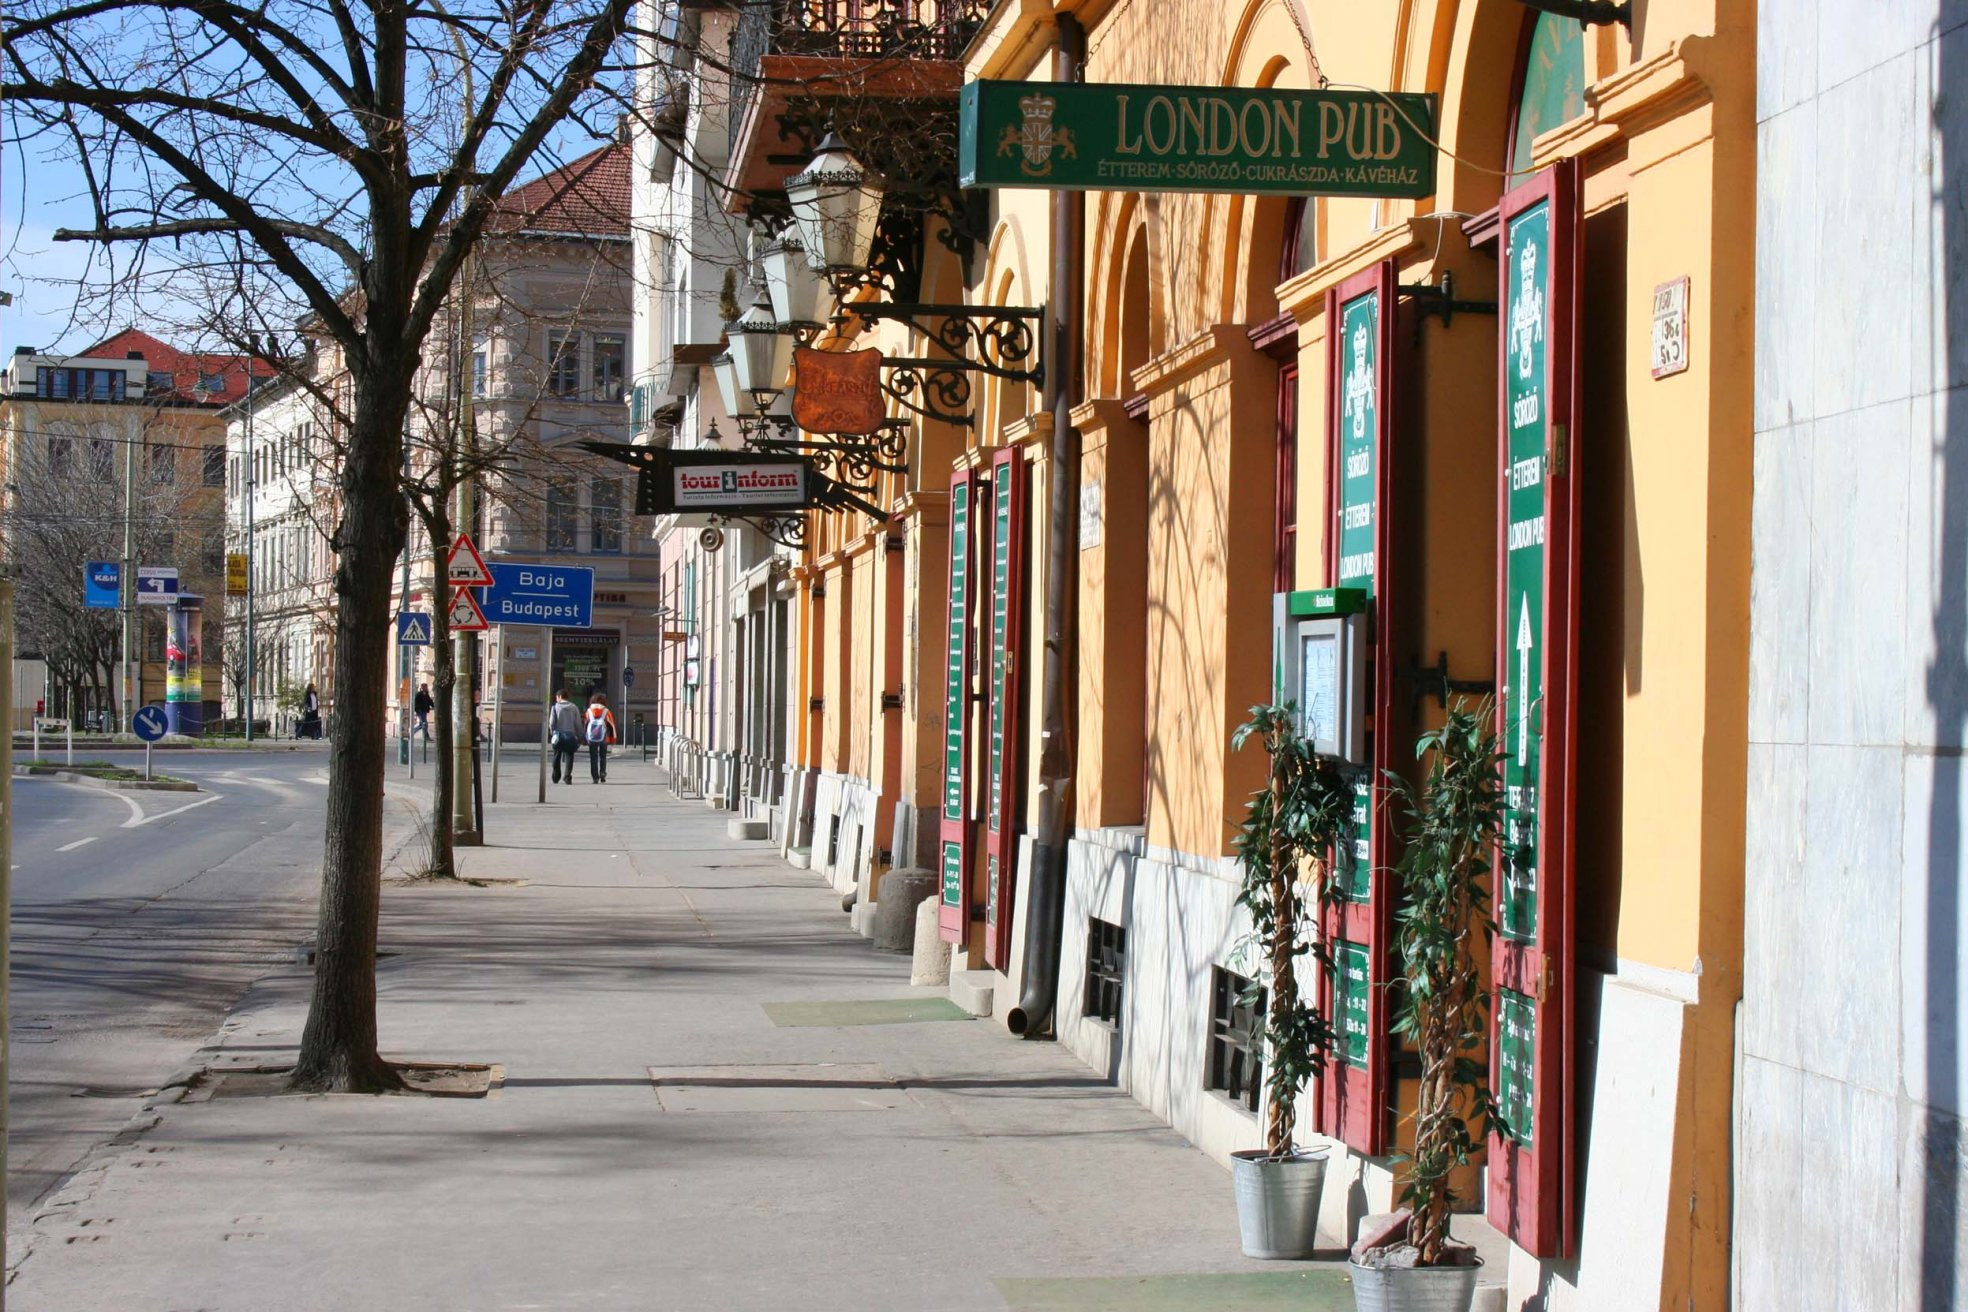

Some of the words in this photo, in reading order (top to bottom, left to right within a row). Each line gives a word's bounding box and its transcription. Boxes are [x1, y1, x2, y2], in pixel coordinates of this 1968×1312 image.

[1115, 96, 1302, 158] LONDON
[1317, 101, 1401, 161] PUB
[1097, 159, 1172, 178] ÉTTEREM
[1246, 163, 1340, 183] CUKRÁSZDA
[1345, 166, 1418, 185] KÁVÉHÁZ
[1513, 456, 1540, 490] ÉTTEREM
[1345, 501, 1370, 530] ÉTTEREM
[1509, 519, 1532, 551] LONDON
[1533, 516, 1544, 546] PUB
[95, 574, 117, 582] K&H
[1341, 553, 1362, 579] LONDON
[1363, 552, 1374, 576] PUB
[520, 572, 565, 590] Baja
[502, 600, 579, 619] Budapest
